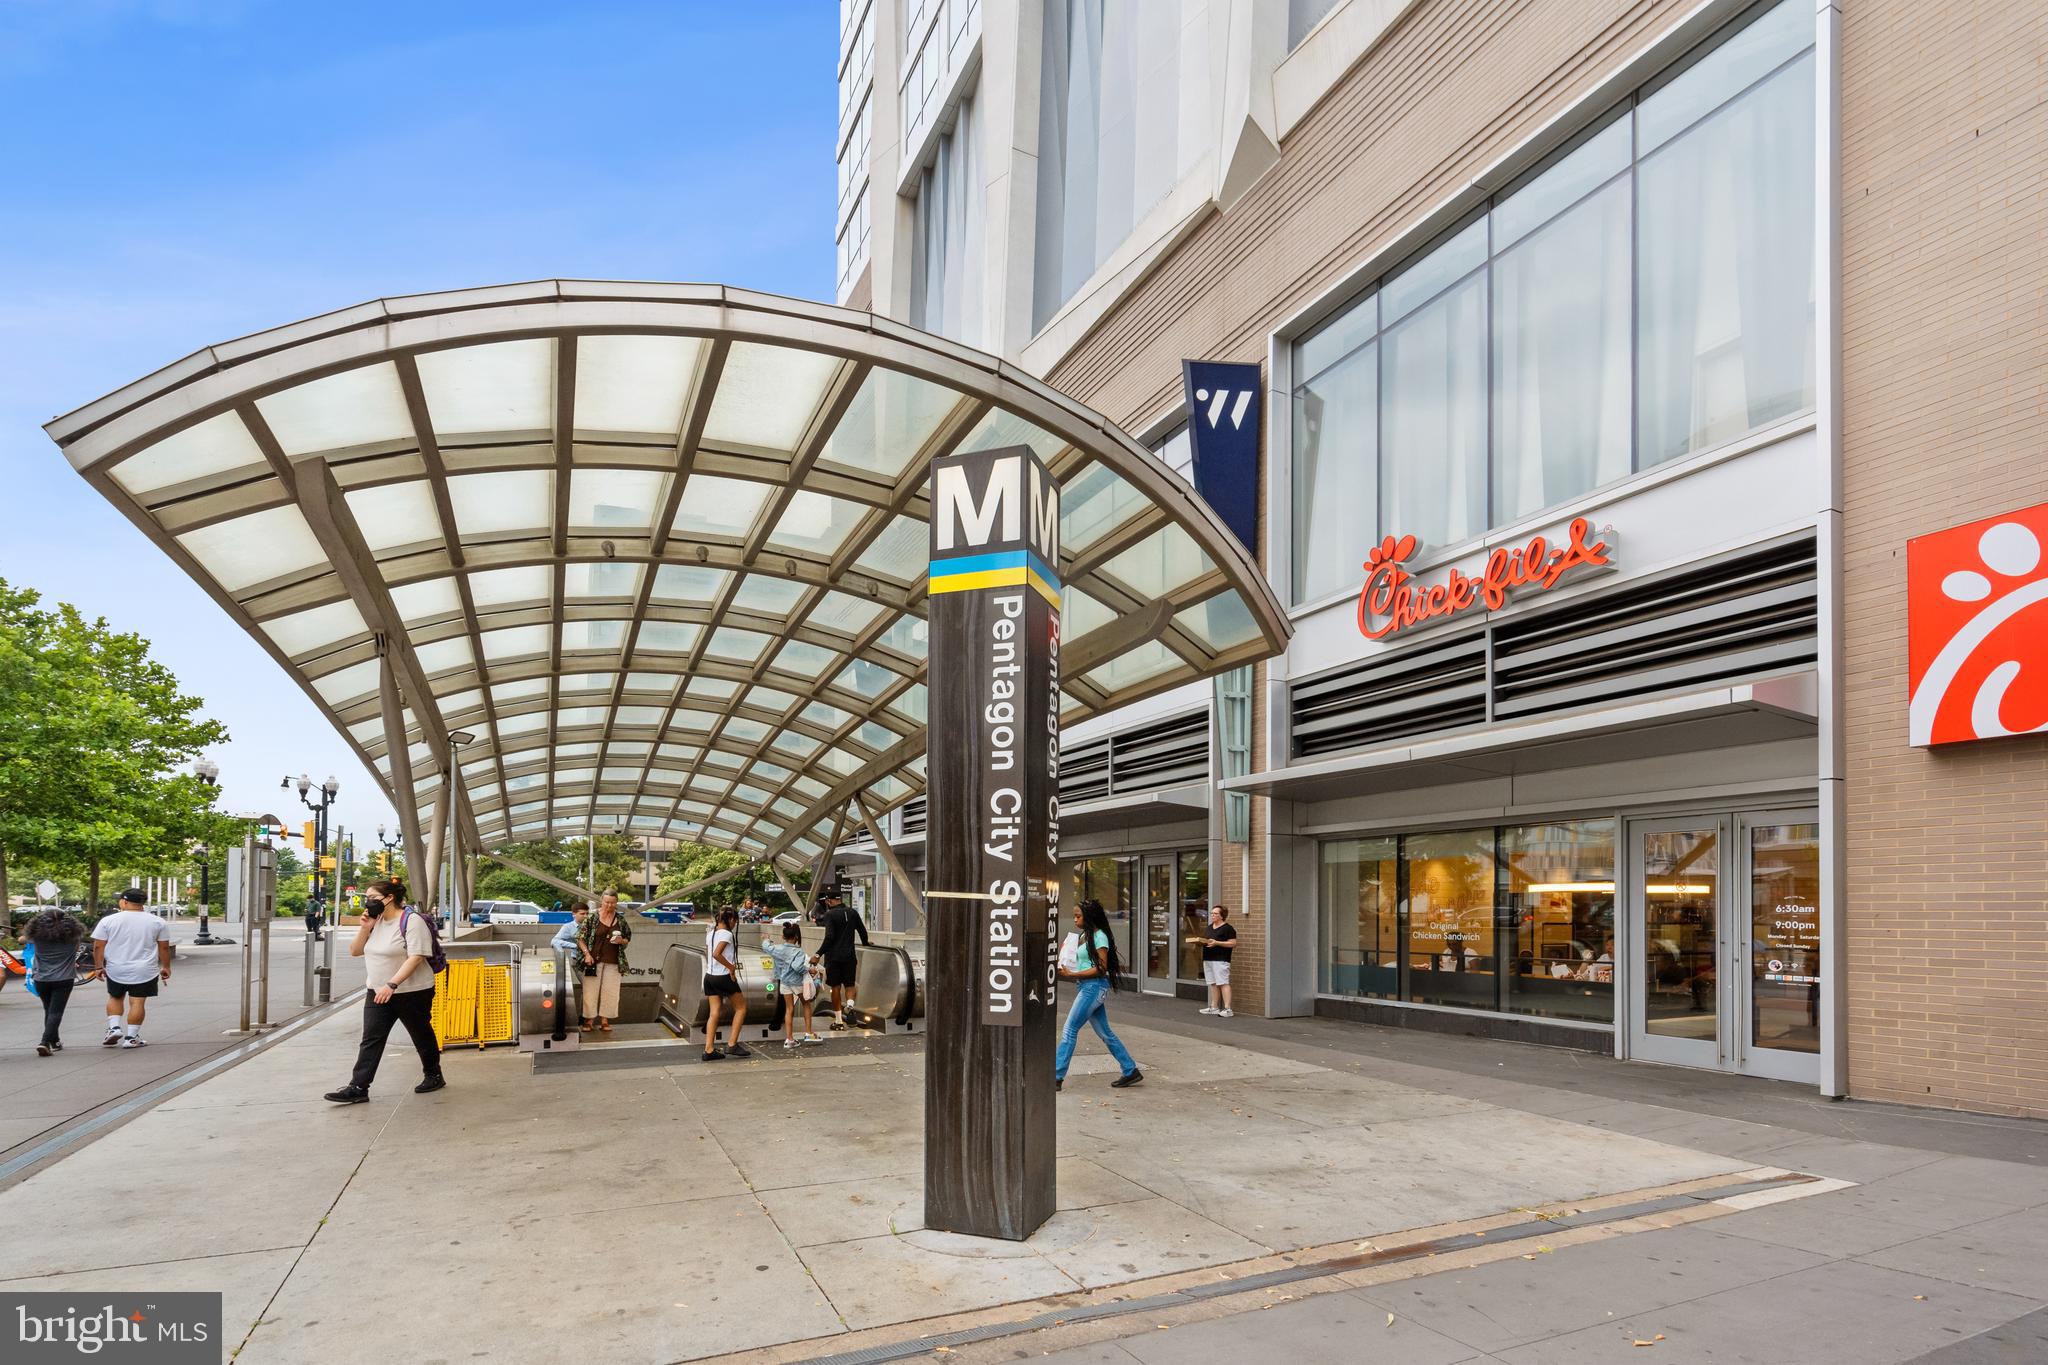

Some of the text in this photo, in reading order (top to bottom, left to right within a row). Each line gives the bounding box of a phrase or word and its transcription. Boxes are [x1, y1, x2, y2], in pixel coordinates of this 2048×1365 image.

[937, 456, 1021, 550] M
[1030, 460, 1057, 568] M
[1357, 517, 1609, 639] Chick-fil-A
[984, 595, 1023, 1012] Pentagon City Station
[1046, 614, 1060, 1006] Pentagon City Station
[630, 968, 645, 976] City
[1413, 931, 1481, 941] Chicken Sandwich
[1430, 922, 1459, 931] Original
[1776, 921, 1815, 930] 9:00pm
